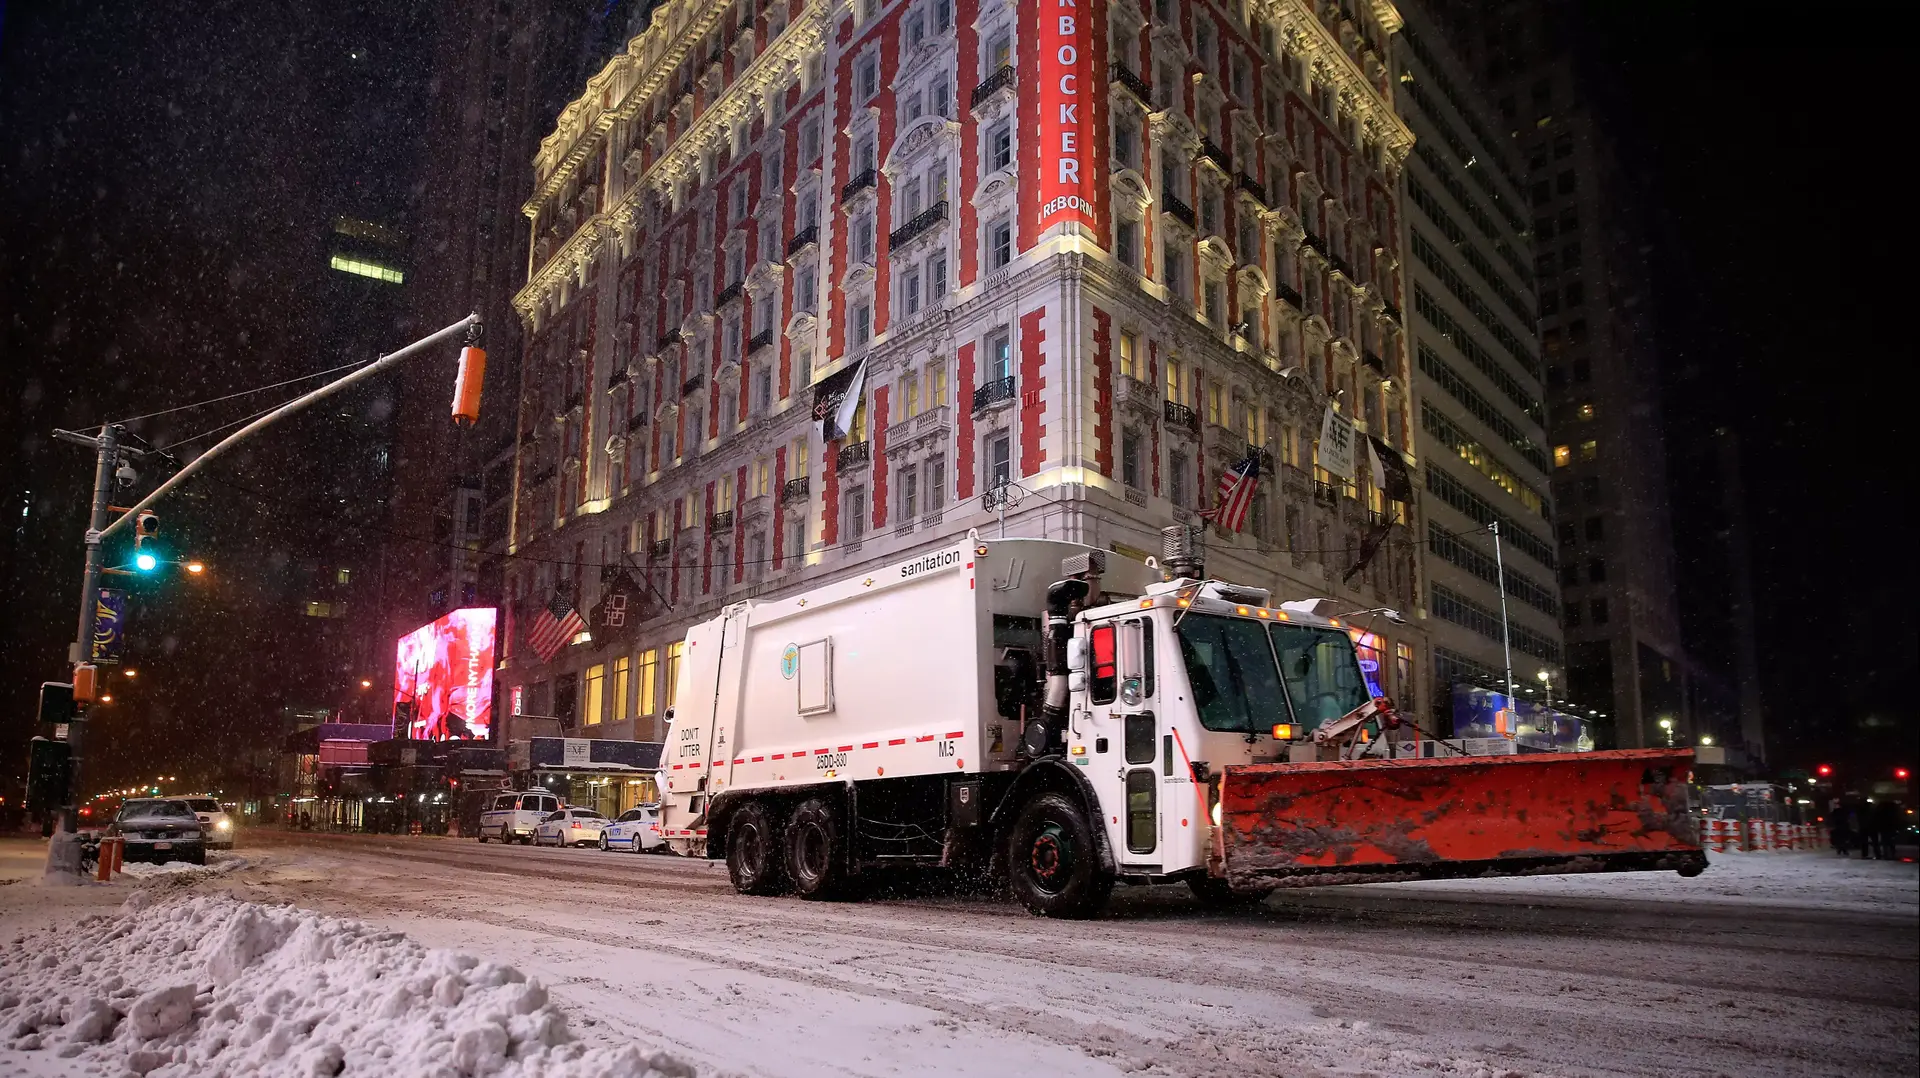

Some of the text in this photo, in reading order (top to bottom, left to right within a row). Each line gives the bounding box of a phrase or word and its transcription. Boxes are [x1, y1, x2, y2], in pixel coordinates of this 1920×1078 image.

[1043, 195, 1093, 219] REBORN
[901, 550, 960, 578] sanitation
[681, 727, 700, 741] DON'T
[680, 743, 701, 758] LITTER
[938, 740, 955, 757] M.5
